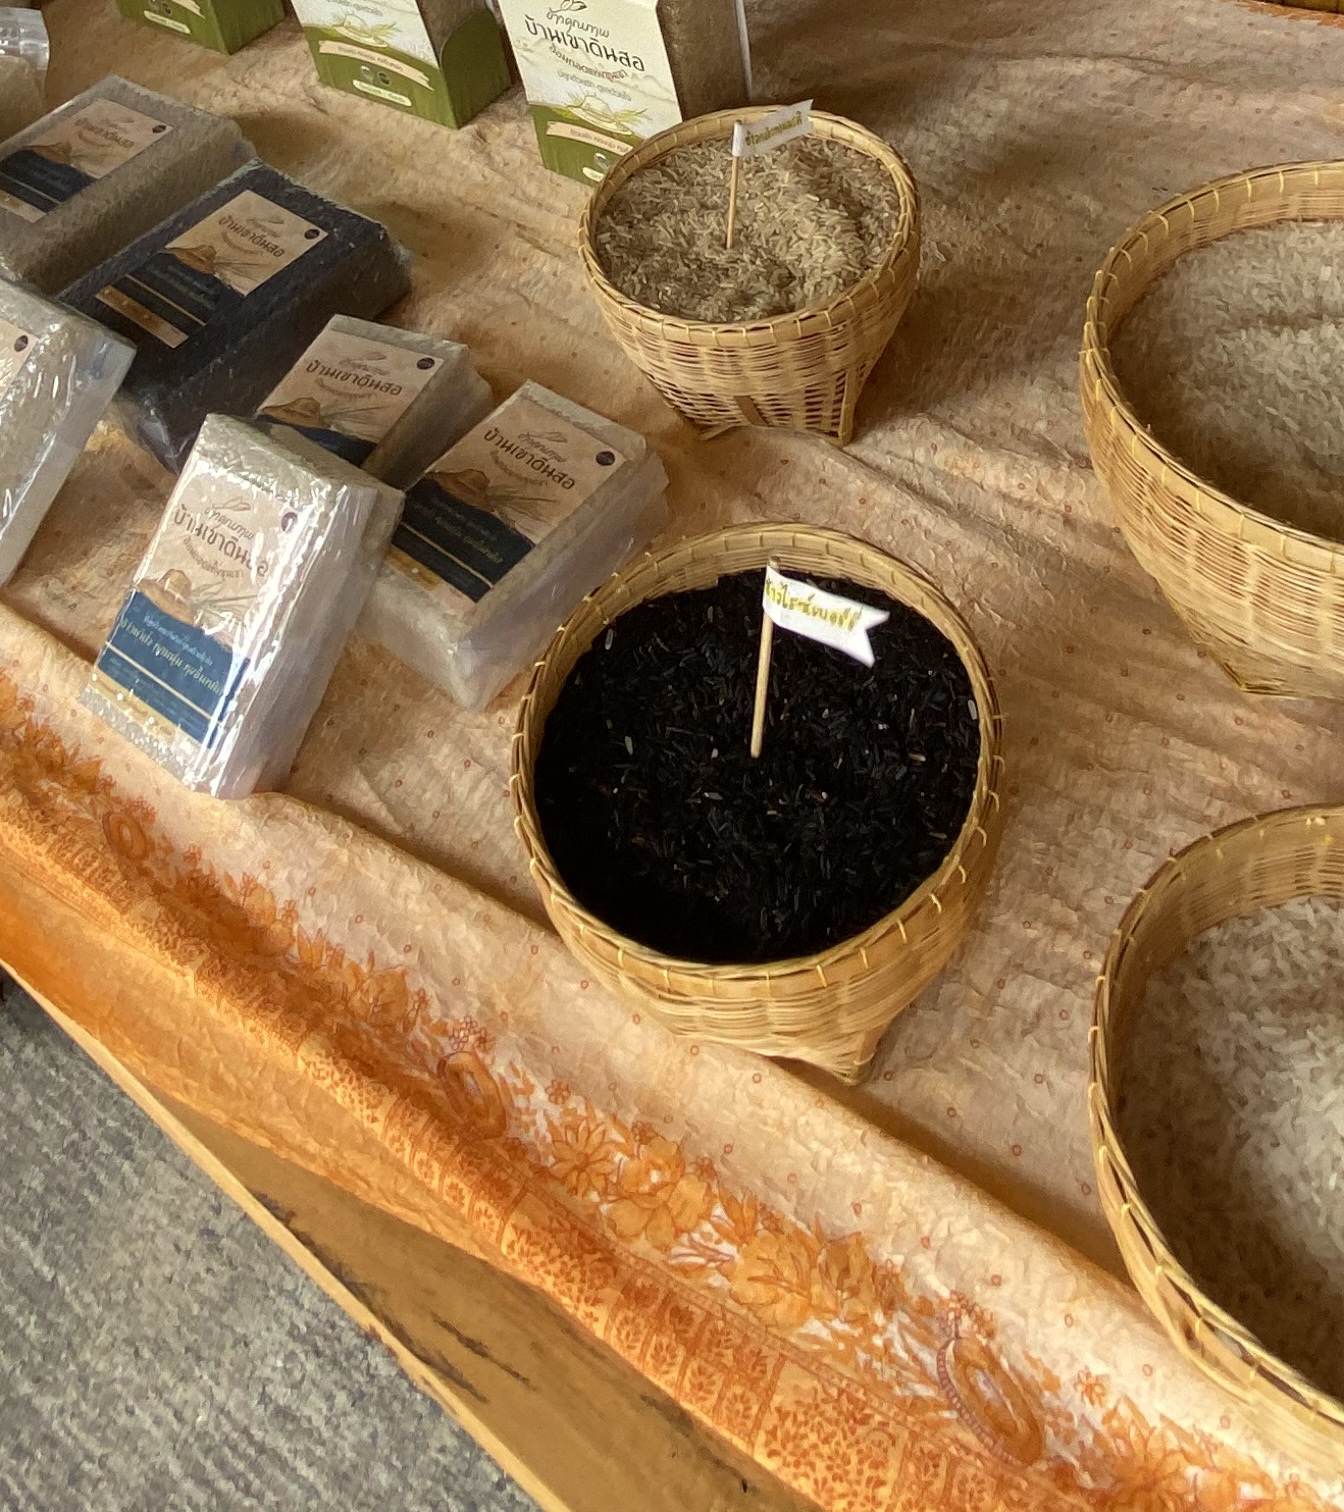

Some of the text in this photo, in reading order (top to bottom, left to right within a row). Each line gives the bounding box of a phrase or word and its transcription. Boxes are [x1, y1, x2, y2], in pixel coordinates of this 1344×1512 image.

[524, 14, 646, 72] บ้านเขาดินสอ
[306, 359, 403, 396] บ้านเขาดินสอ
[483, 426, 577, 490] บ้านเขาดินสอ
[173, 503, 269, 577] บ้านเขาดินอ
